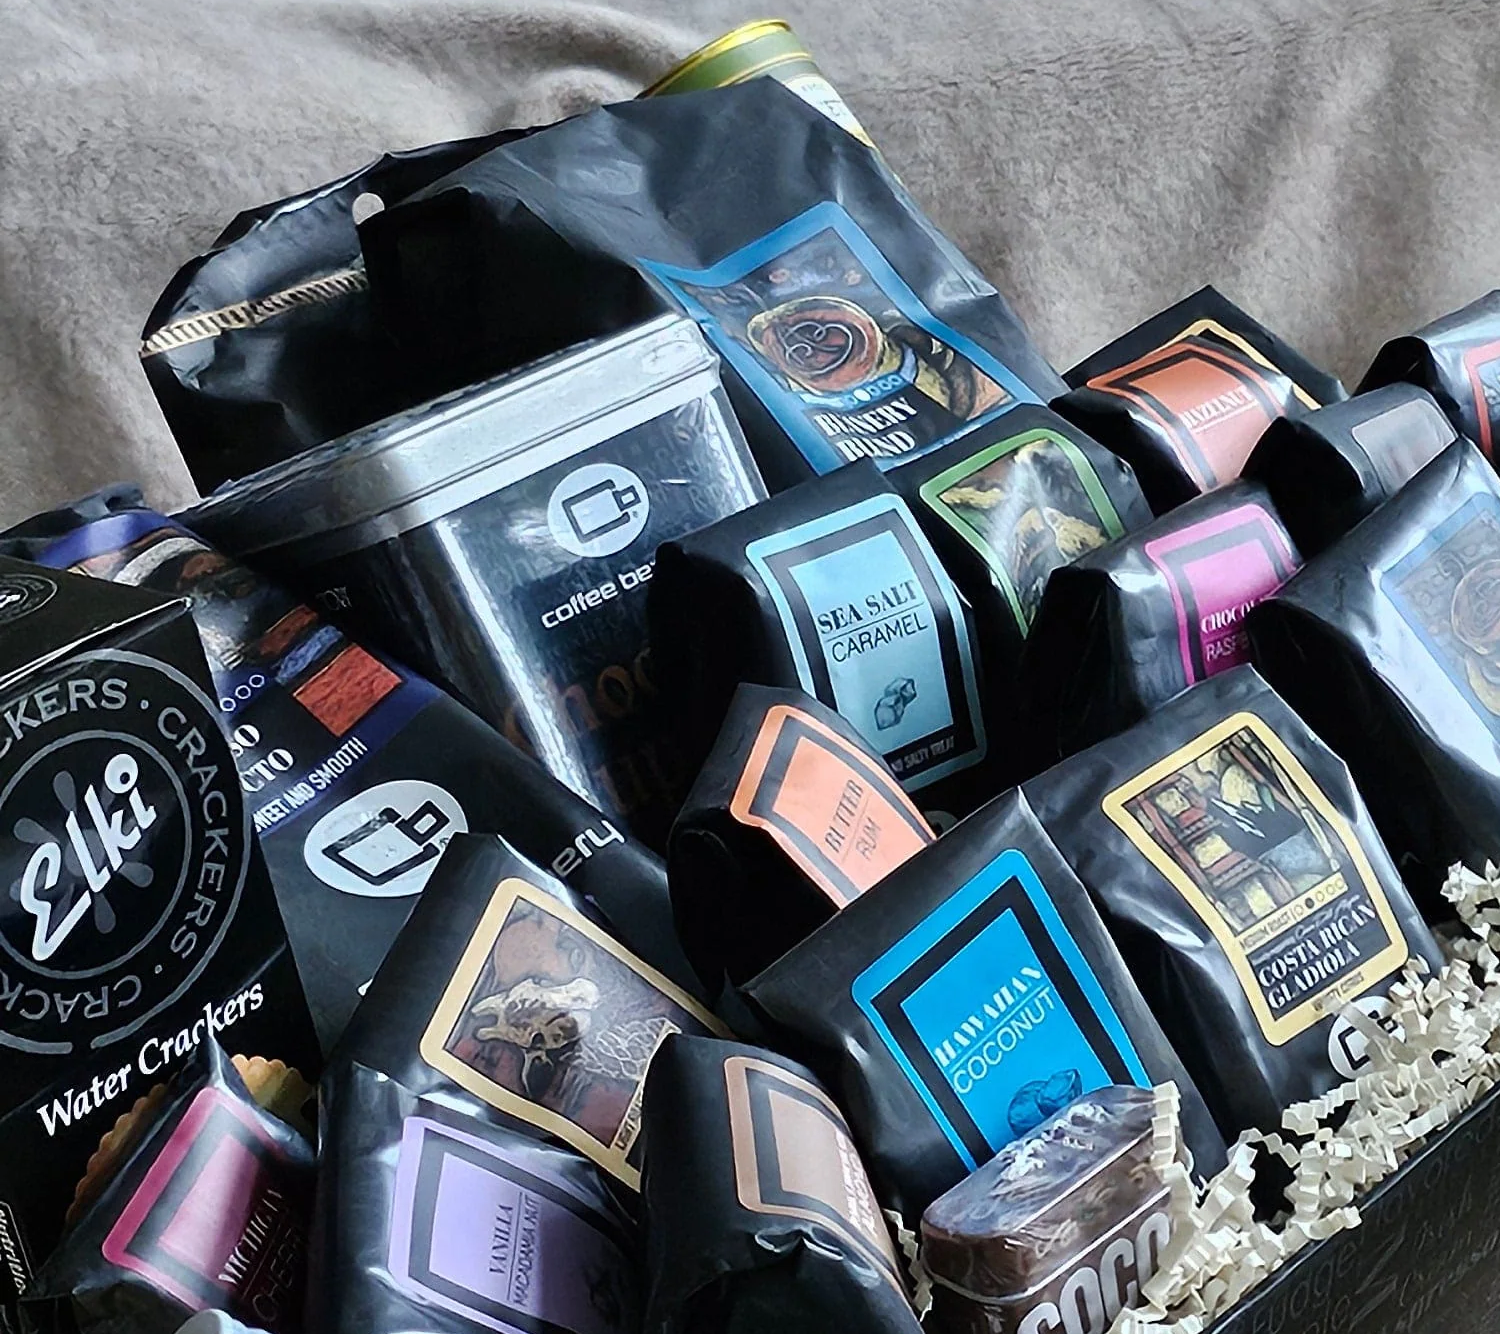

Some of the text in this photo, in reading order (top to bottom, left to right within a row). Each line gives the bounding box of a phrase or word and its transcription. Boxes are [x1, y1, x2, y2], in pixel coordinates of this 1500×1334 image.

[541, 556, 656, 629] coffee be
[817, 579, 917, 634] SEA SALT
[1201, 599, 1255, 634] CHOCO
[831, 612, 928, 663] CARAMEL
[308, 736, 369, 791] SMOOTH
[20, 753, 157, 961] Elki
[1258, 937, 1321, 988] COSTA
[1319, 900, 1377, 950] RICAN
[1268, 939, 1361, 1009] GLADIOLA
[934, 966, 1042, 1068] HAWAIIAN
[953, 986, 1055, 1094] COCONUT
[37, 982, 265, 1137] Water Crackers
[489, 1204, 514, 1274] VANILLA
